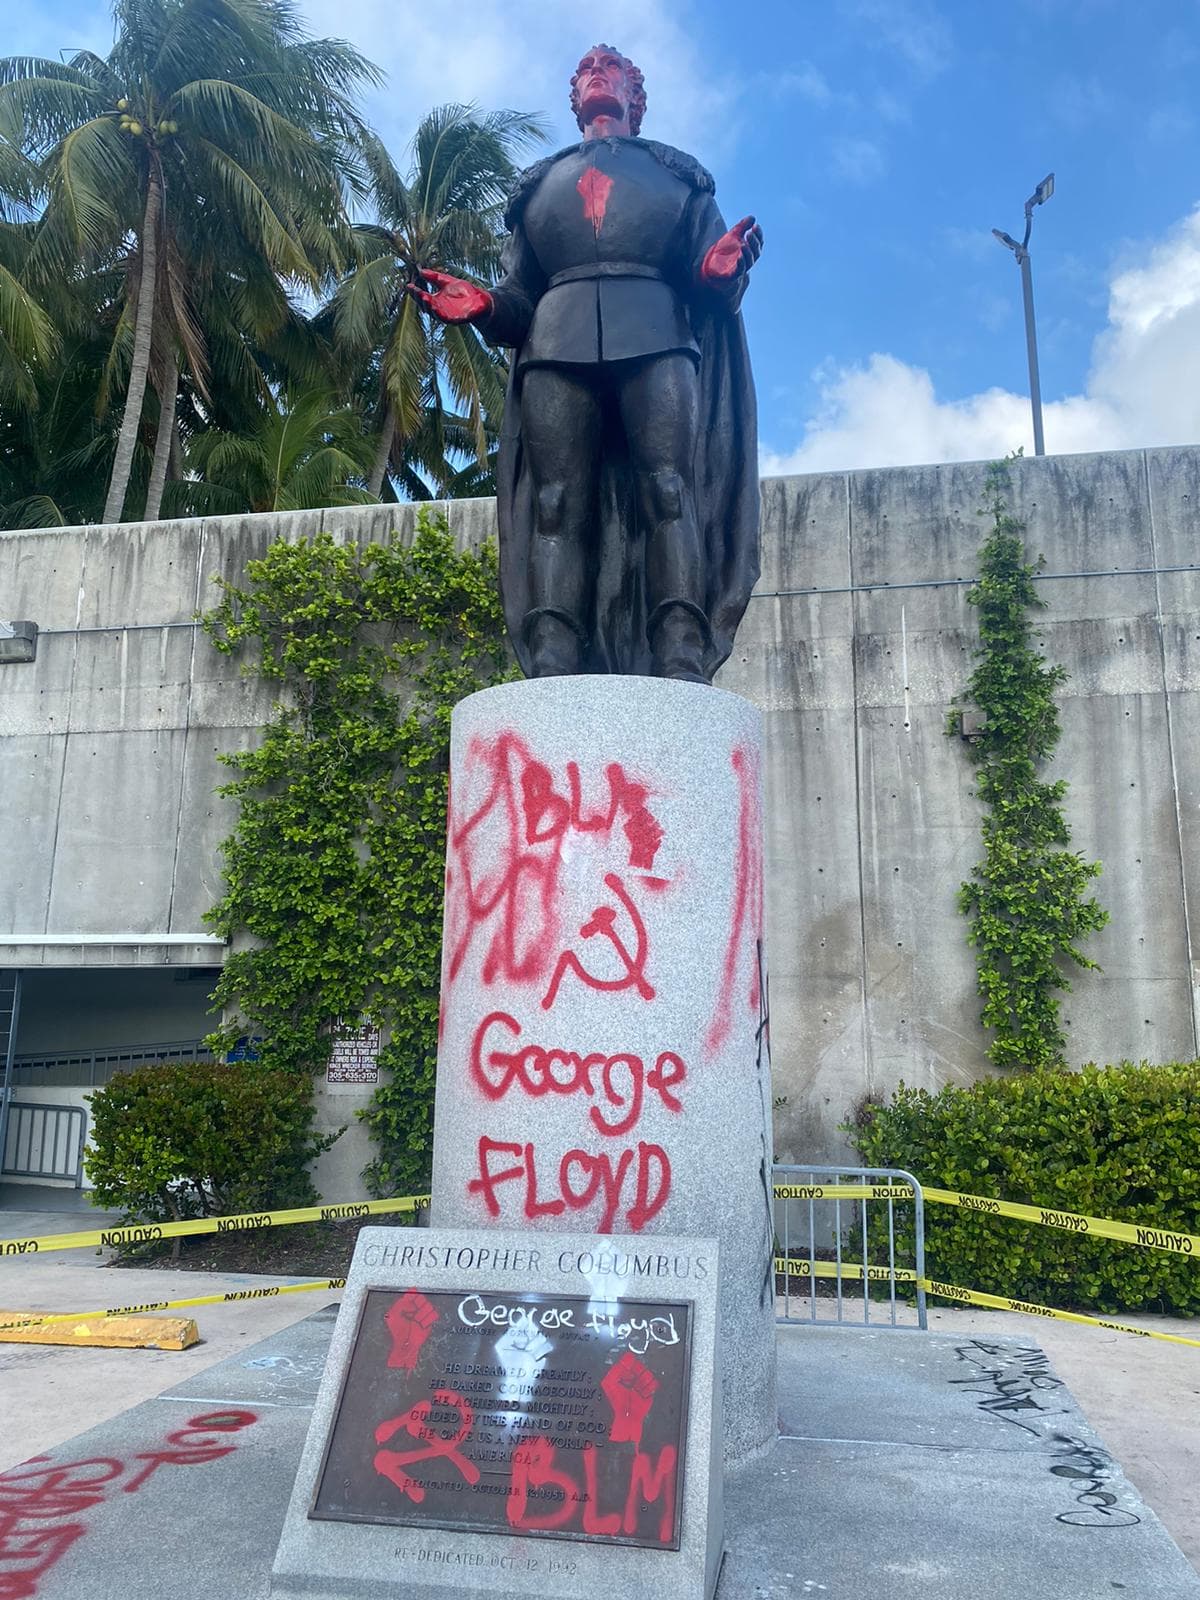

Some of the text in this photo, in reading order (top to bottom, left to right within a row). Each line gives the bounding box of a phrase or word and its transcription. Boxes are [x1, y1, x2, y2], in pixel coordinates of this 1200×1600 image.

[468, 1135, 671, 1233] FLOYD
[773, 1186, 824, 1198] CAUTION
[872, 1187, 915, 1198] AUTION
[321, 1203, 371, 1220] CAUTION
[217, 1214, 272, 1232] CAUTION
[1041, 1210, 1089, 1232] CAUTION
[101, 1226, 162, 1246] CAUTION
[1137, 1227, 1193, 1254] CAUTION
[363, 1243, 709, 1281] CHRISTOPHER COLUMBUS
[775, 1261, 810, 1276] CAUTI
[458, 1294, 576, 1329] George
[443, 1362, 462, 1374] HE
[428, 1378, 446, 1390] HE
[450, 1380, 494, 1393] DARED
[431, 1395, 449, 1407] HE
[464, 1413, 480, 1426] BY
[482, 1415, 507, 1428] THE
[512, 1417, 553, 1430] HAND
[557, 1420, 573, 1432] OF
[417, 1427, 437, 1440] HE
[477, 1431, 493, 1444] US
[495, 1433, 505, 1445] A
[508, 1432, 539, 1447] NEW
[545, 1435, 593, 1451] WORLD
[403, 1478, 463, 1493] DEDICATED
[506, 1434, 676, 1543] BLM
